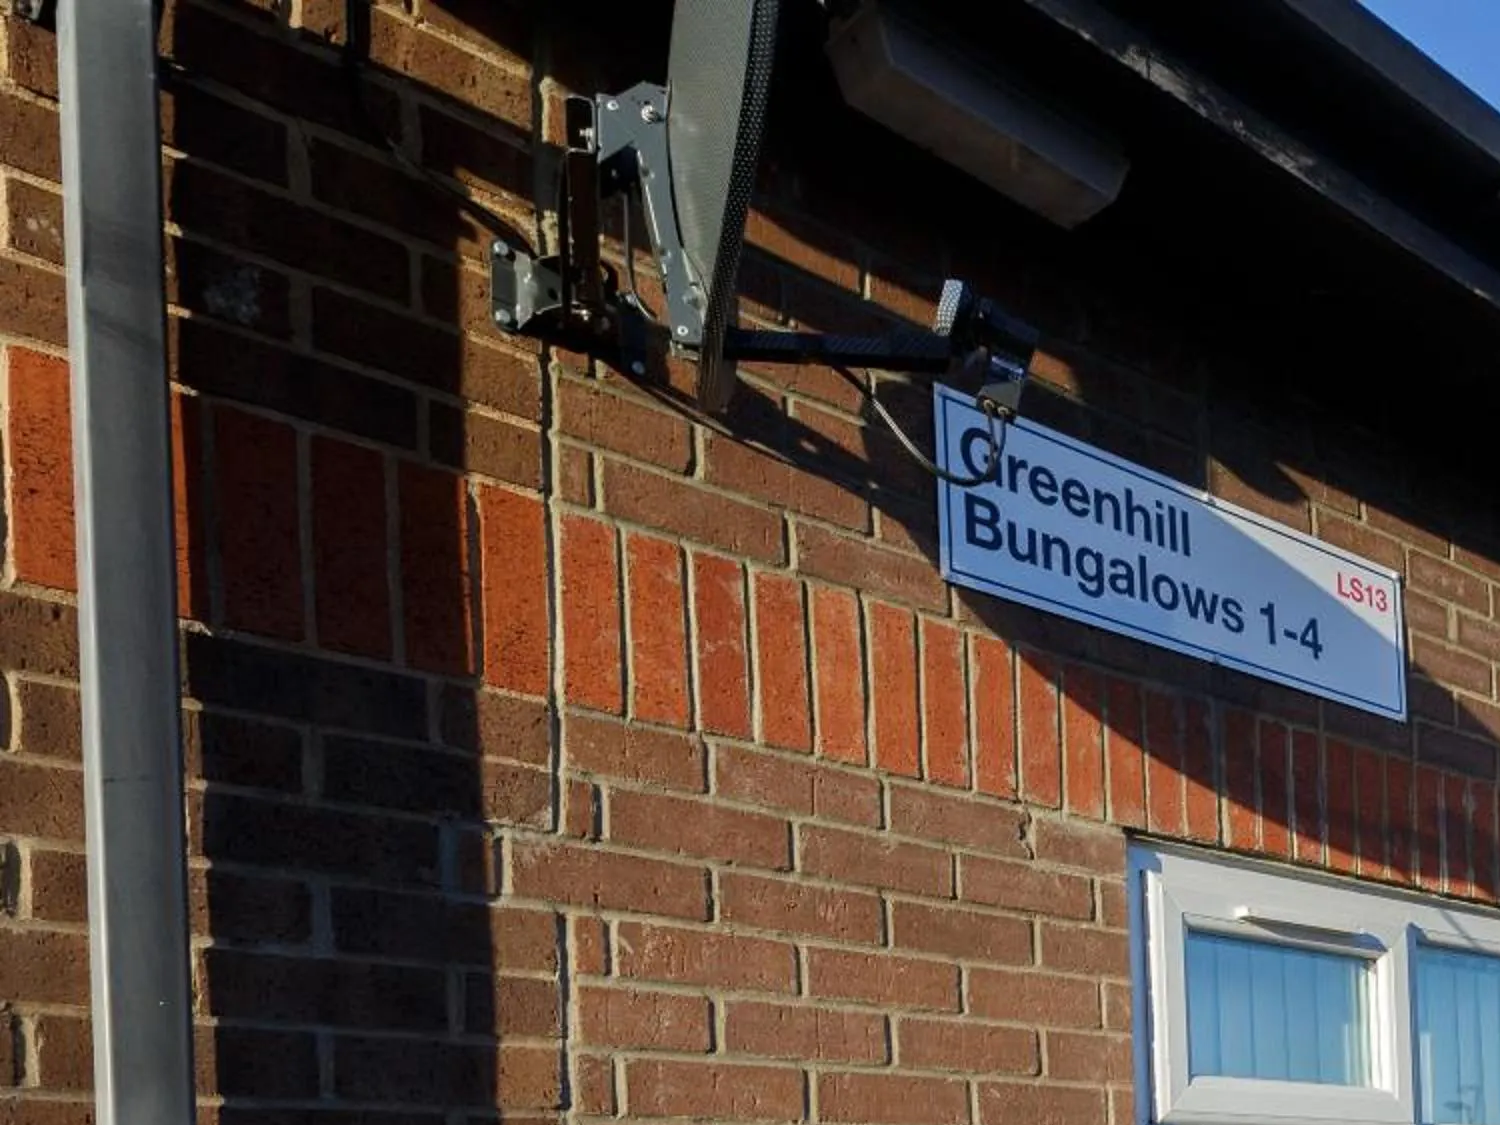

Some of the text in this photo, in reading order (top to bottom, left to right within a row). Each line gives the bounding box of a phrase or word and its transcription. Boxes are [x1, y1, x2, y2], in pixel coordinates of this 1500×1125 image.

[960, 426, 1191, 556] Greenhill
[964, 491, 1324, 660] Bungalows 1-4
[1336, 571, 1388, 613] LS13
